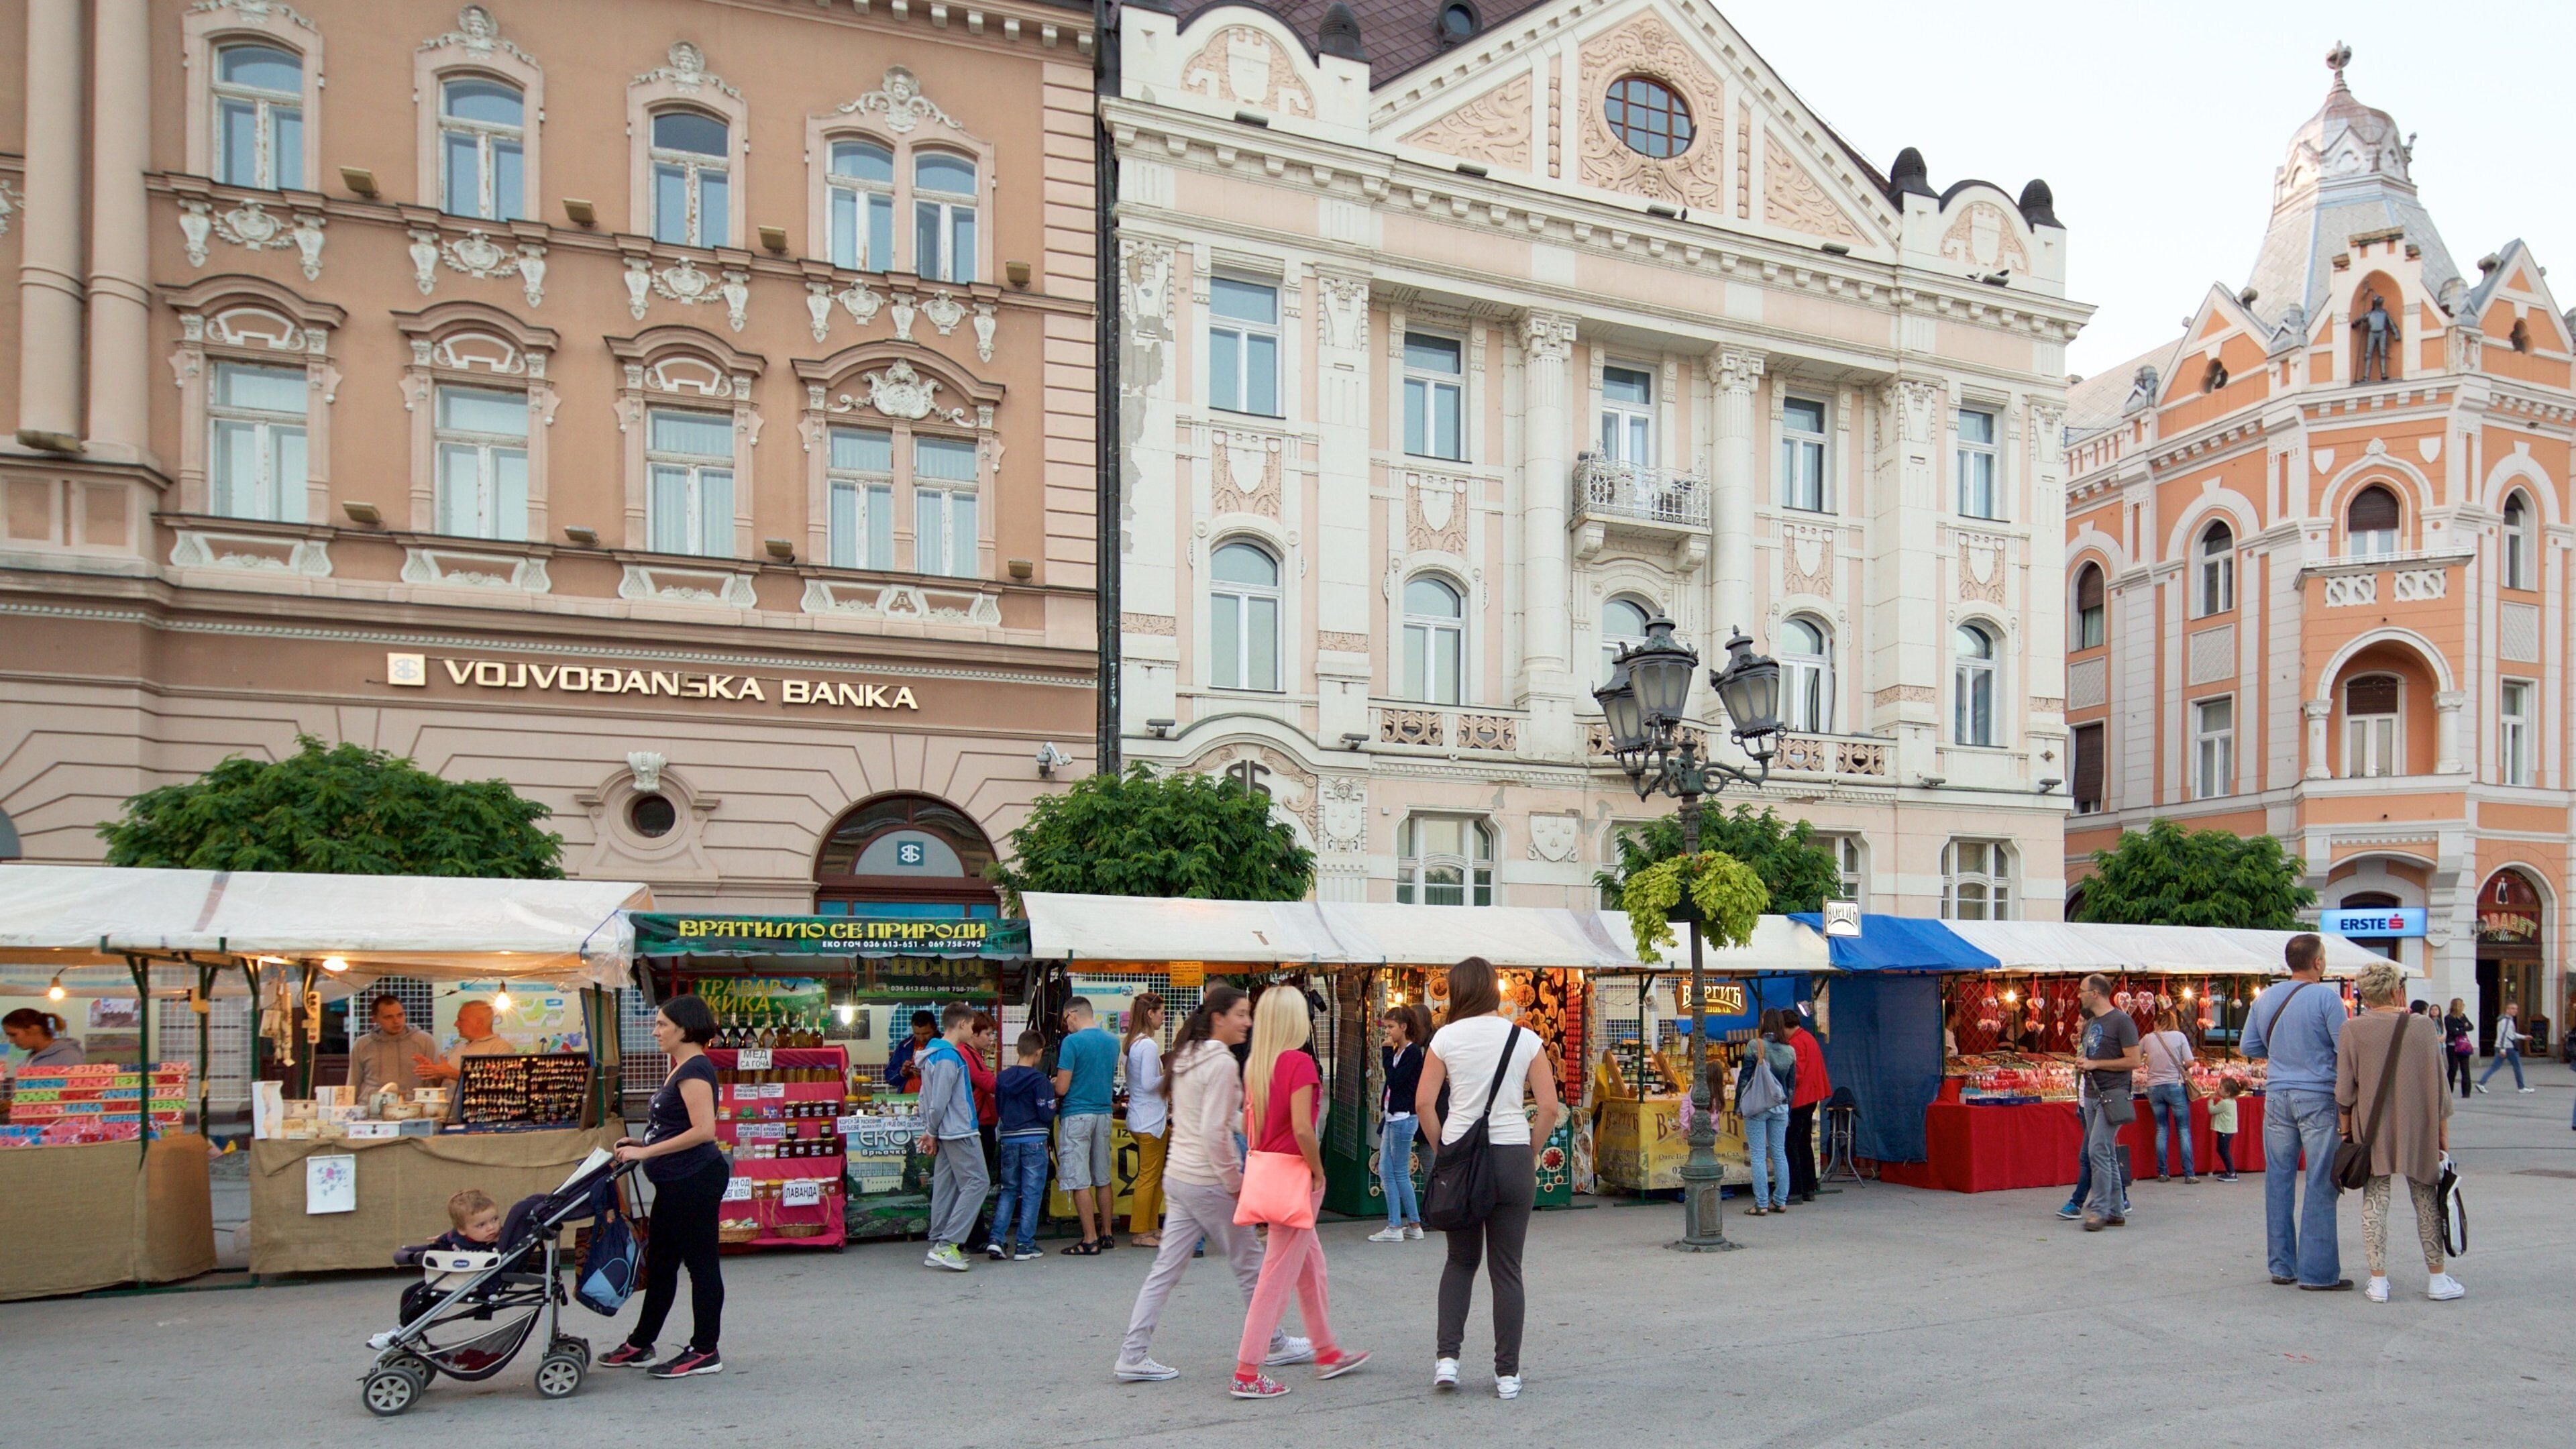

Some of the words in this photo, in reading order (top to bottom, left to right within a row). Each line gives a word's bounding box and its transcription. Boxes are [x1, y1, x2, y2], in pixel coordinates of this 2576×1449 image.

[444, 659, 765, 701] VOJVOĐANSKA
[782, 680, 918, 710] BANKA
[680, 920, 826, 938] ВРАТИМО
[829, 922, 863, 938] СЕ
[867, 922, 986, 938] ПРИРОДИ
[2341, 918, 2386, 930] ERSTE
[2481, 912, 2537, 938] ABARET
[698, 979, 782, 994] ТРАВАР
[1682, 985, 1741, 1007] ВРГИЋ
[743, 1050, 767, 1060] МЕД
[741, 1060, 749, 1068] СА
[751, 1059, 769, 1068] ГОЧА
[740, 1179, 749, 1187] ОД
[786, 1186, 817, 1199] ЛАВАНДА
